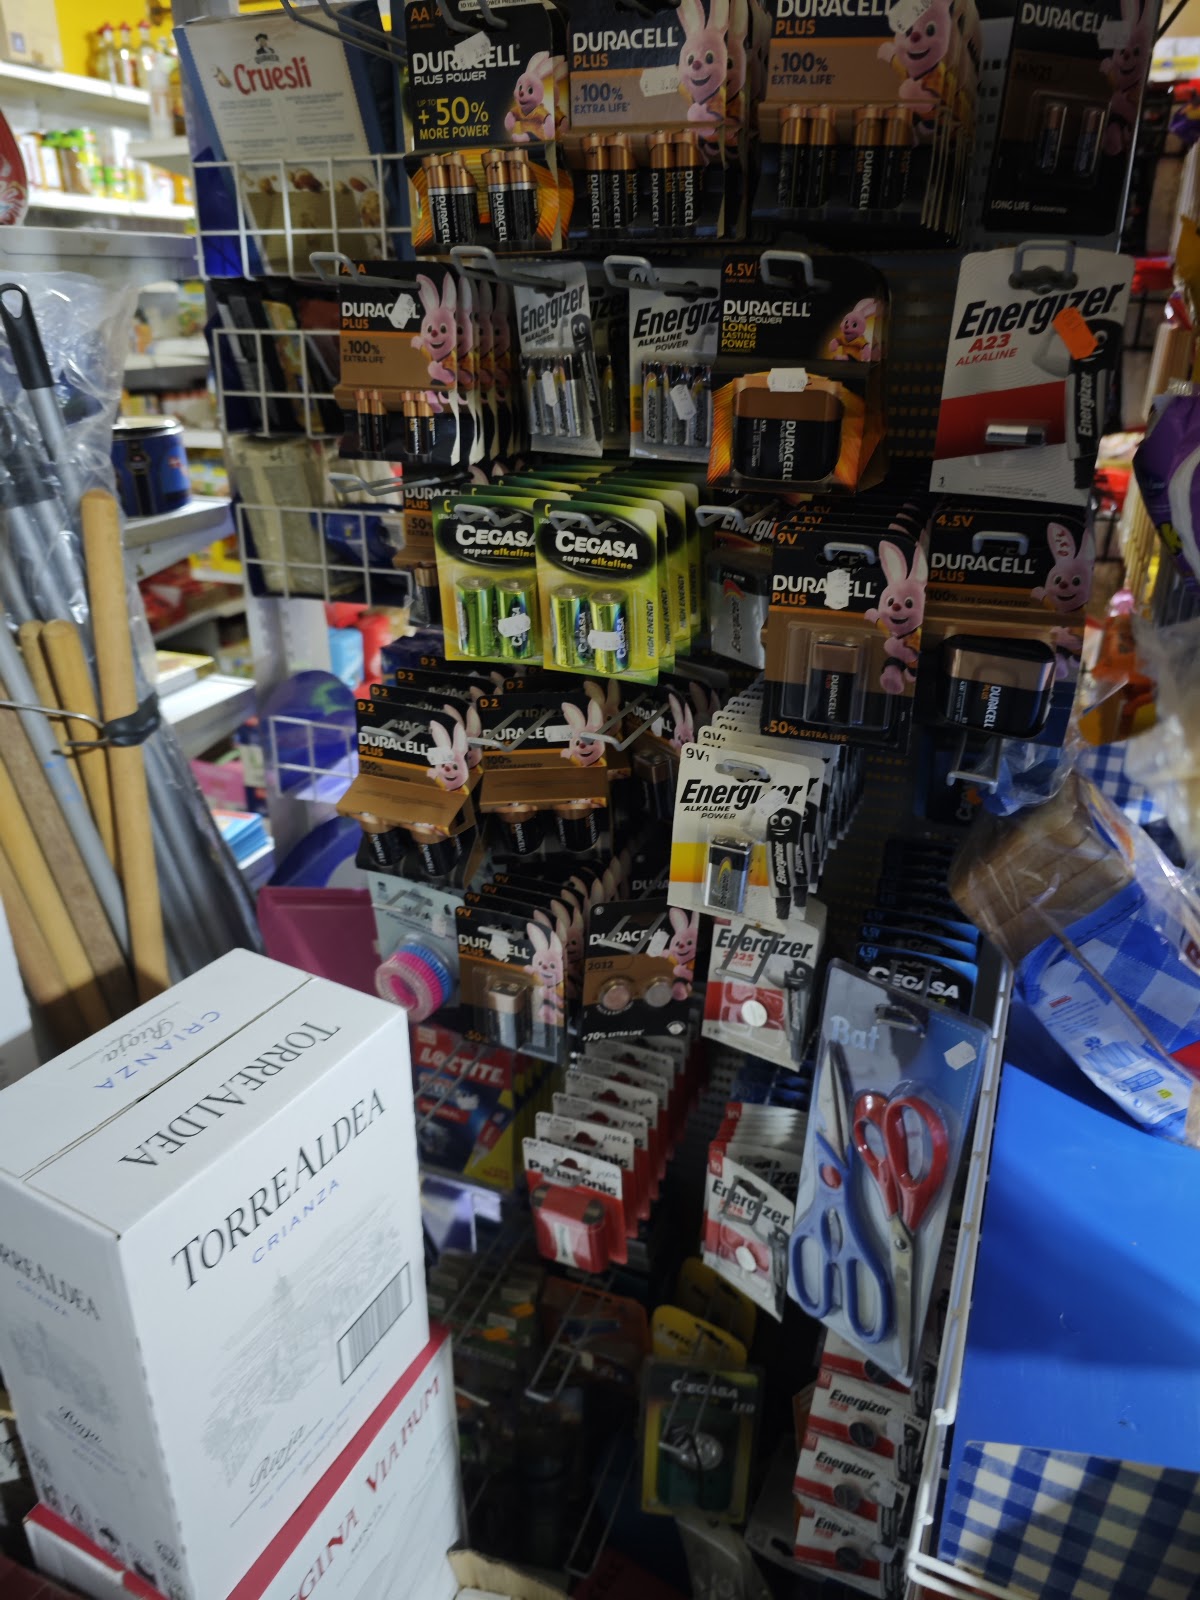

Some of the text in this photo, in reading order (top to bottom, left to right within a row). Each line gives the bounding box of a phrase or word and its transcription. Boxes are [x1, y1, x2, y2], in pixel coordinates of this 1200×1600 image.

[410, 7, 430, 23] AA
[775, 20, 816, 36] PLUS
[573, 28, 677, 53] DURACELL
[573, 54, 608, 69] PLUS
[233, 56, 313, 96] Cruesli
[414, 70, 487, 87] PLUS POWER
[772, 74, 803, 86] EXTRA
[574, 105, 604, 121] EXTRA
[420, 127, 449, 141] MORE
[725, 262, 754, 279] 4.5V
[520, 285, 585, 336] Energizer
[724, 299, 811, 319] DURACELL
[955, 283, 1125, 341] Energizer
[342, 318, 369, 330] PLUS
[722, 322, 757, 333] LONG
[723, 315, 783, 325] PLUS POWER
[638, 332, 683, 348] ALKALINE
[722, 331, 757, 341] LASTING
[968, 333, 1012, 354] A23
[655, 341, 689, 354] POWER
[721, 339, 757, 351] POWER
[956, 347, 1018, 367] ALKALINE
[1078, 372, 1093, 437] Energizer
[405, 499, 431, 512] PLUS
[443, 500, 451, 513] C
[936, 513, 974, 529] 4.5V
[555, 531, 639, 561] CEGASA
[776, 531, 799, 545] 9V
[464, 545, 492, 559] super
[562, 554, 633, 571] super alkaline
[931, 552, 1038, 575] DURACELL
[929, 569, 967, 583] PLUS
[772, 574, 876, 600] DURAELL
[771, 592, 808, 606] PLUS
[646, 599, 656, 657] HIGH ENERGY
[480, 698, 500, 709] D 2
[827, 674, 840, 719] DURACELL
[357, 700, 376, 713] D 2
[983, 686, 1002, 729] DURACELL
[800, 728, 829, 740] EXTRA
[358, 732, 430, 757] DURACELL
[360, 745, 385, 758] PLUS
[683, 804, 732, 813] ALKALINE
[700, 812, 738, 821] POWER
[92, 1010, 221, 1090] CRIANZA
[118, 1020, 342, 1168] TORREALDEA
[170, 1088, 387, 1291] TORREALDEA
[251, 1178, 341, 1264] CRIANZA
[829, 1388, 893, 1417] Energizer
[815, 1451, 877, 1480] Energizer
